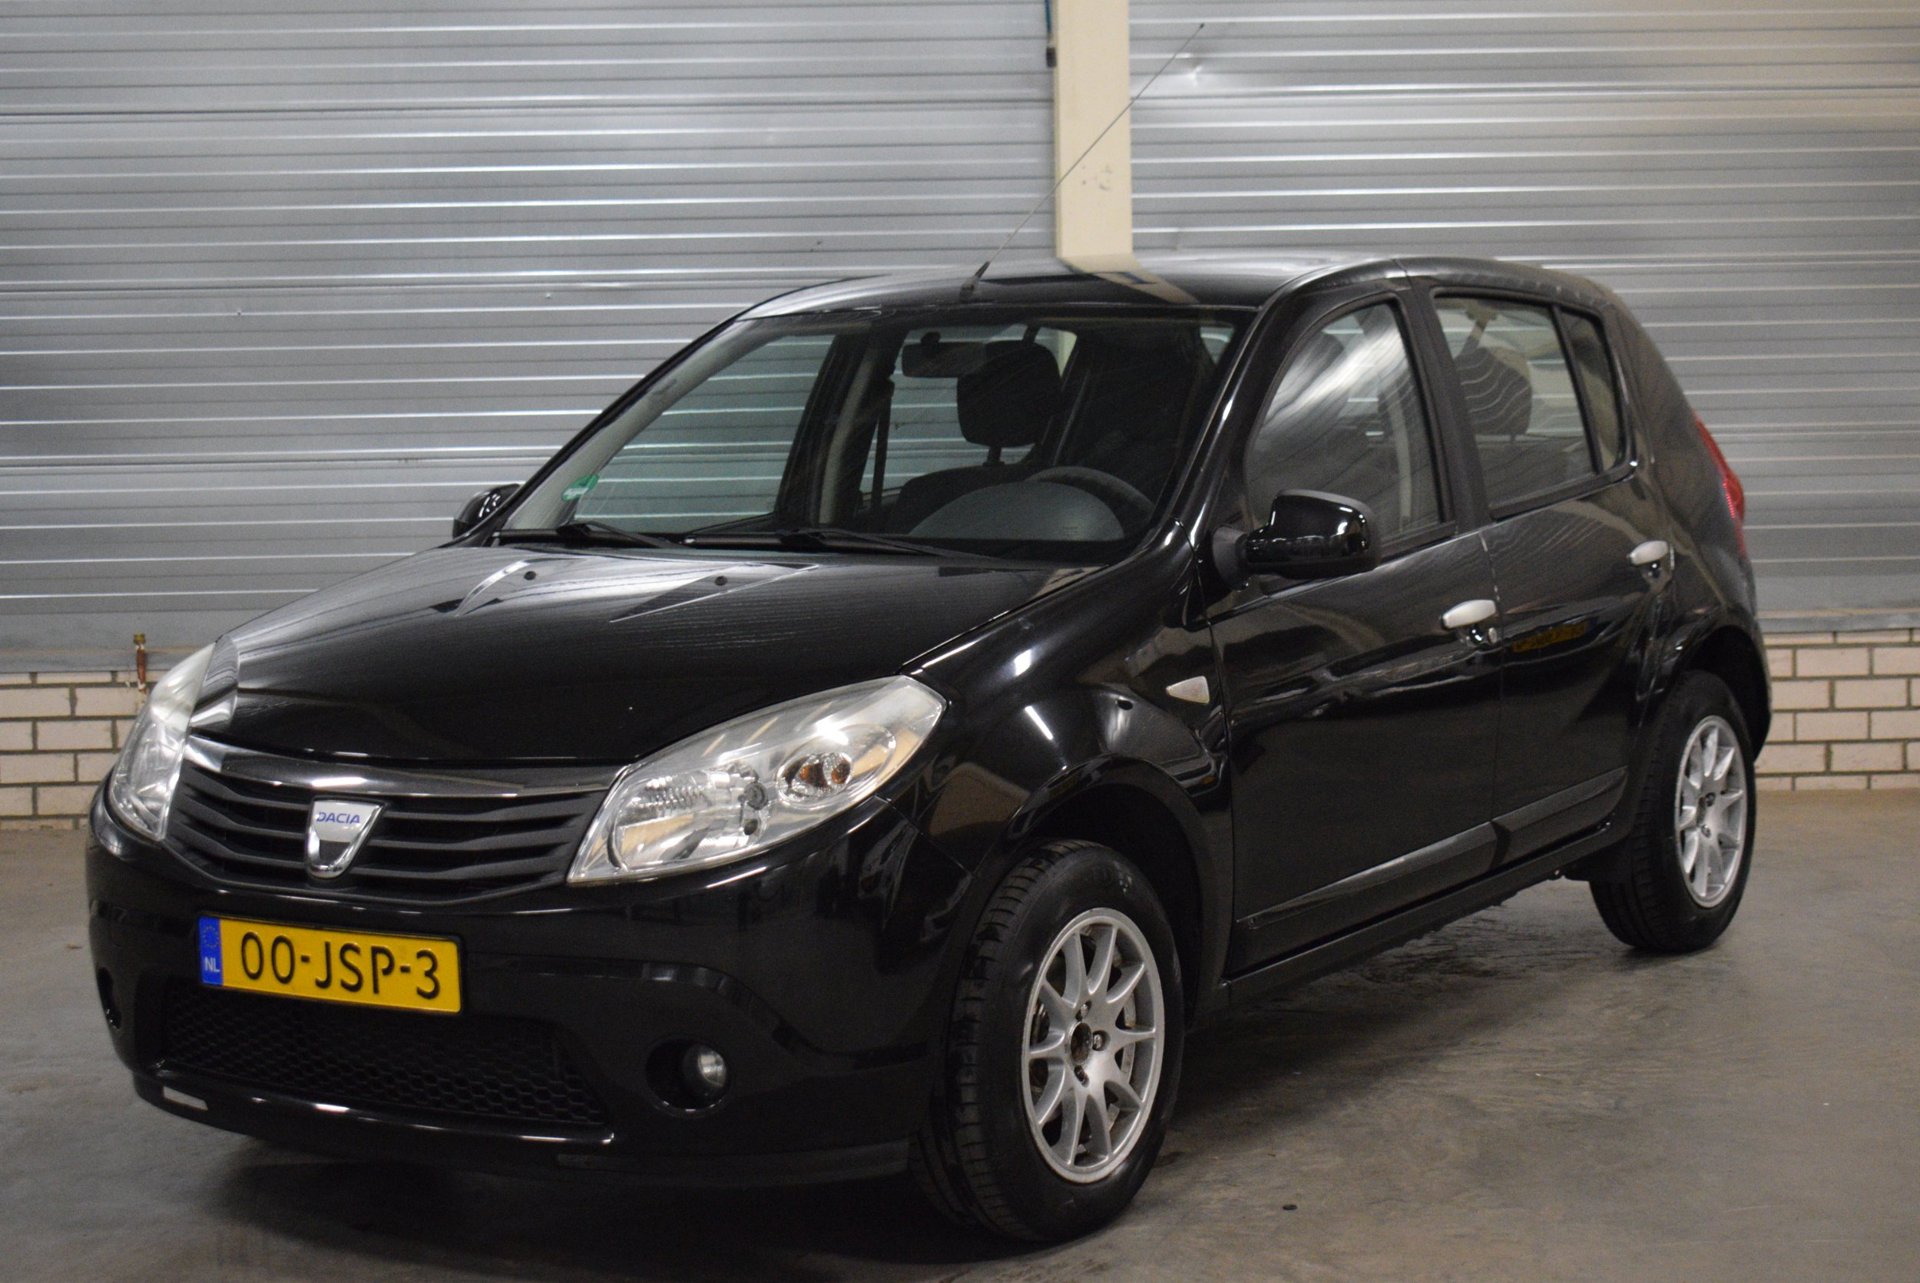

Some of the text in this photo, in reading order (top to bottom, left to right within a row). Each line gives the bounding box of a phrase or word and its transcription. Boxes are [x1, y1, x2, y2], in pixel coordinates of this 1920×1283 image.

[316, 811, 361, 824] DACIA
[204, 957, 221, 973] NL
[241, 931, 441, 999] 00-JSP-3
